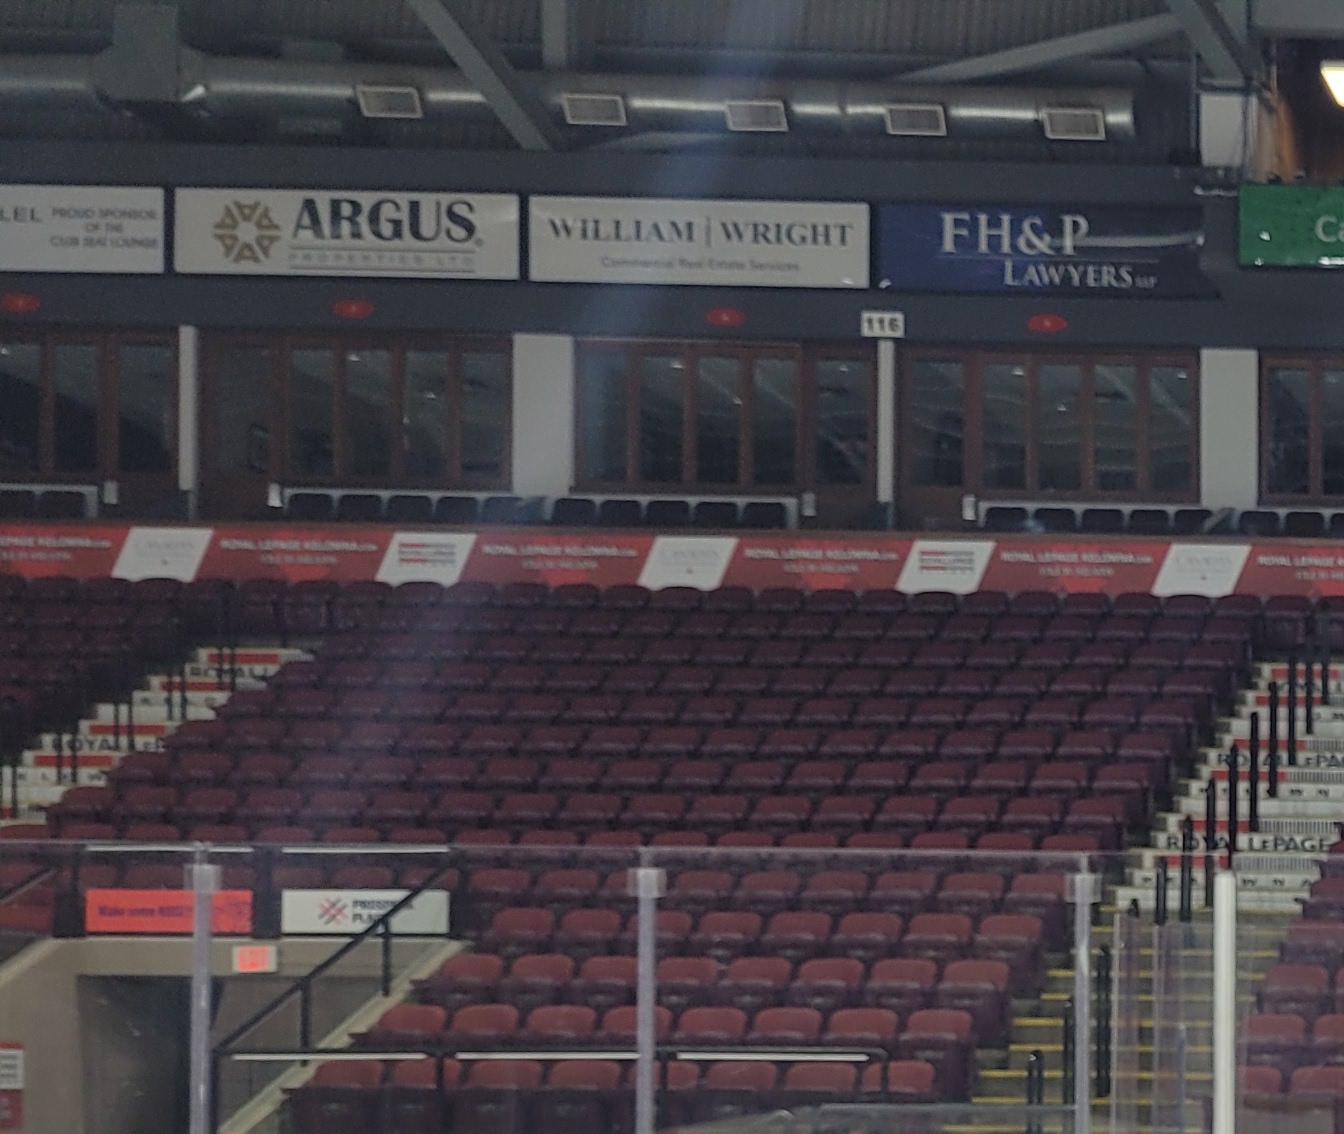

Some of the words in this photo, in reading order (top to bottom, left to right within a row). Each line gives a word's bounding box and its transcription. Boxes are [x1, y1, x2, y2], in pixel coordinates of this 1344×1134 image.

[292, 198, 477, 243] ARGUS
[548, 217, 694, 243] WILLIAM
[721, 221, 853, 246] WRIGHT
[940, 211, 1089, 256] FH&P
[1004, 258, 1134, 288] LAWYERS
[868, 316, 901, 332] 116
